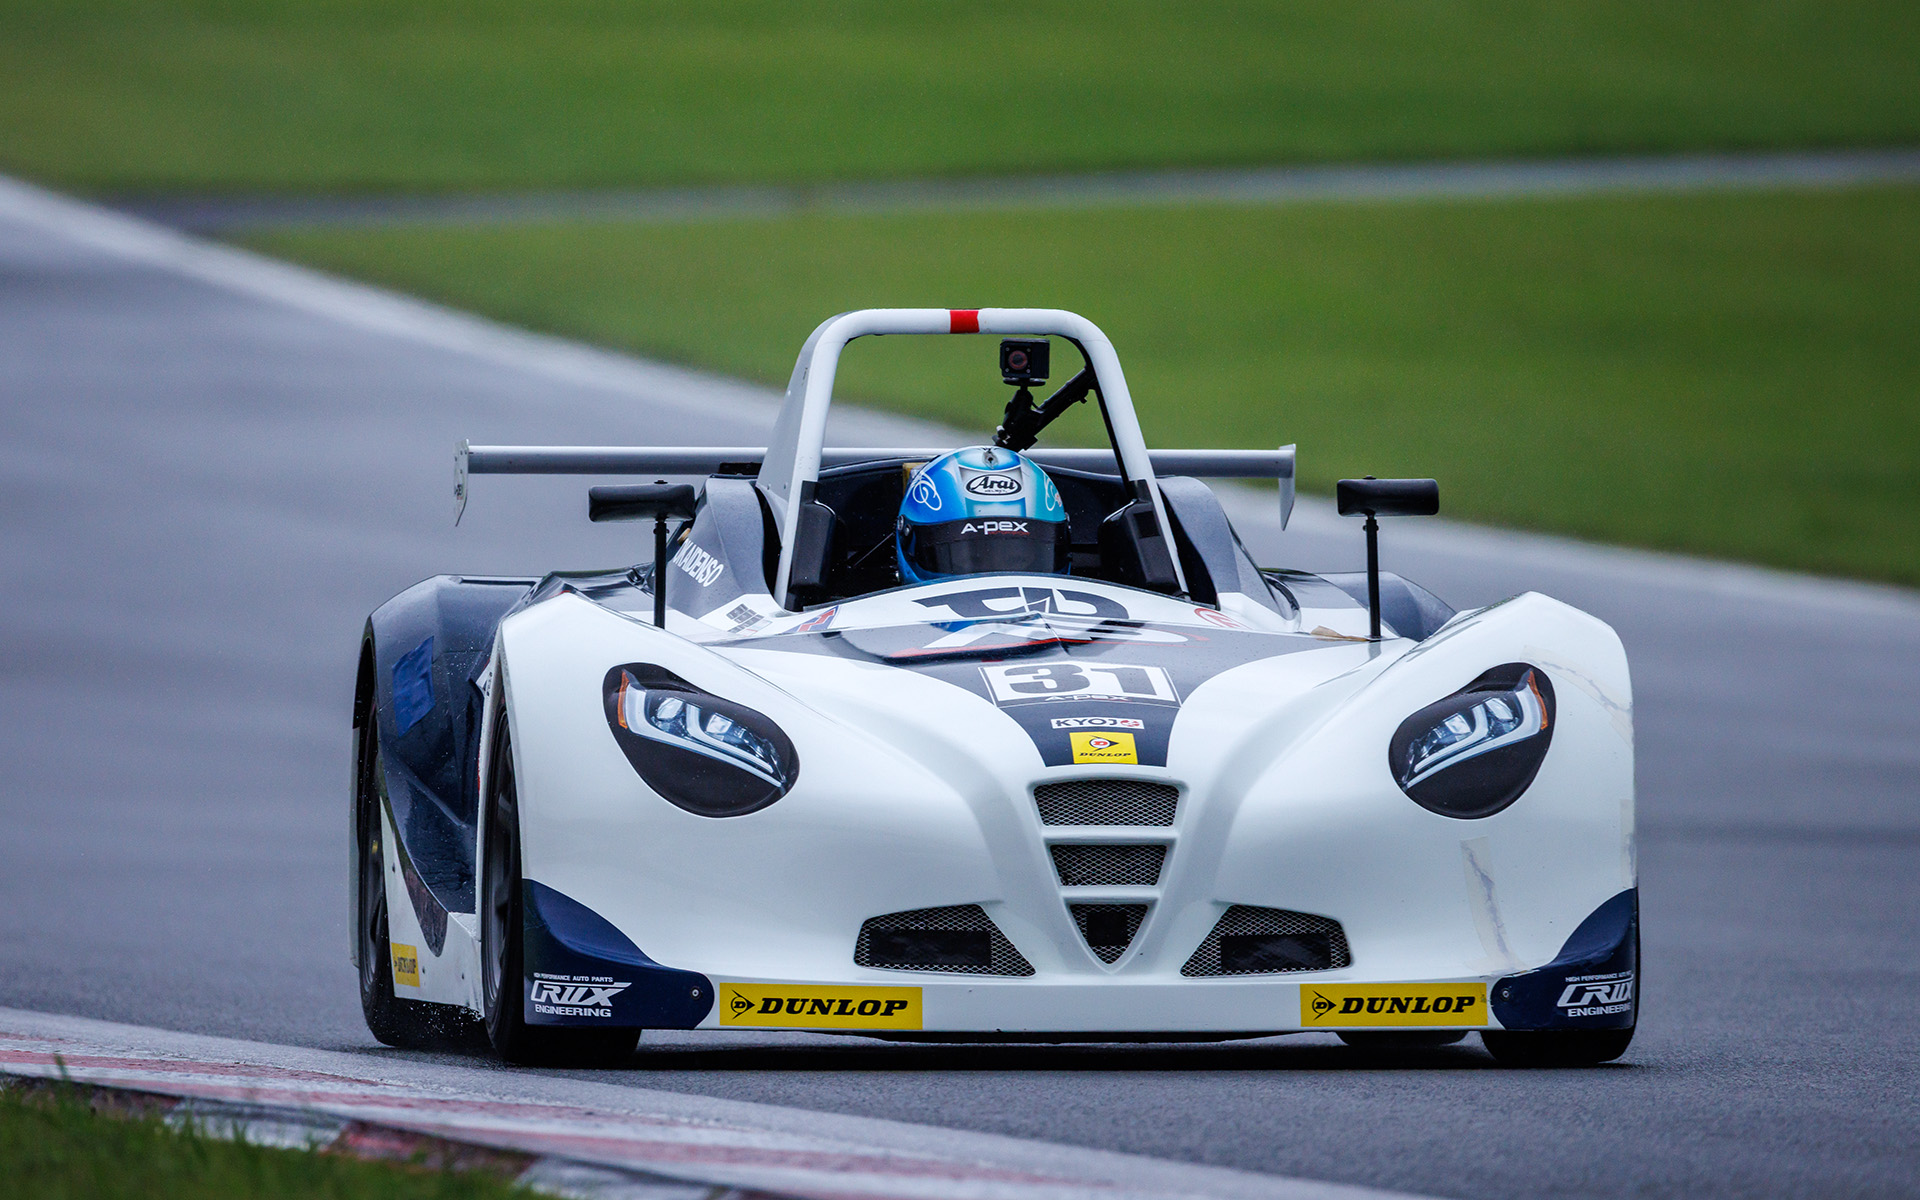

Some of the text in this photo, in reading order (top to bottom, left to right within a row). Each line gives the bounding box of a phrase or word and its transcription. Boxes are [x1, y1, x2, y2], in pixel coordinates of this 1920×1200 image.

[972, 476, 1015, 490] Arai
[1003, 664, 1157, 696] 31
[535, 1003, 612, 1018] ENGINEERING
[757, 997, 908, 1016] DUNLOP
[1338, 996, 1476, 1014] DUNLOP
